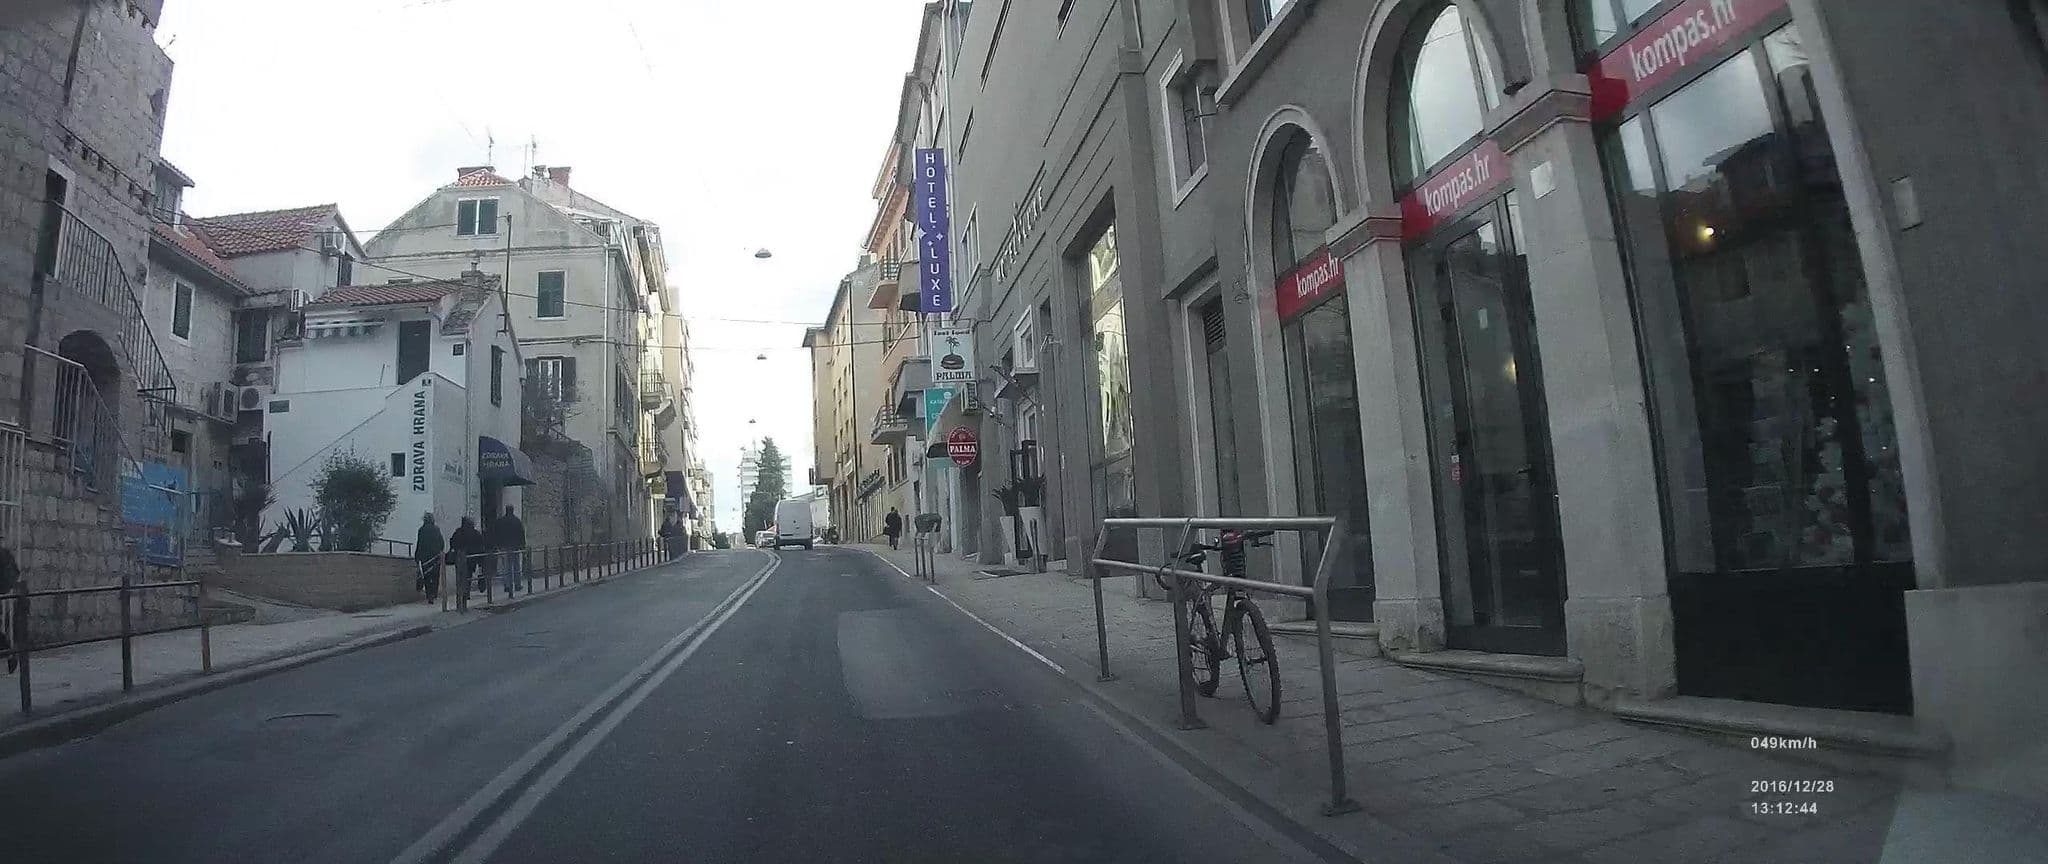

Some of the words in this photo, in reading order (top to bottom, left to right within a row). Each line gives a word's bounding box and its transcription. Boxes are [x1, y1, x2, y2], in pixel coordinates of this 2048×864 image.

[1628, 0, 1737, 82] kompas.hr
[925, 153, 937, 224] HOTEL
[1424, 153, 1490, 217] kompas.hr
[930, 248, 941, 307] LUXE
[1295, 252, 1339, 298] kompas.hr
[413, 391, 425, 435] HRANA
[413, 441, 425, 491] ZDRAVA
[949, 445, 976, 454] PALMA
